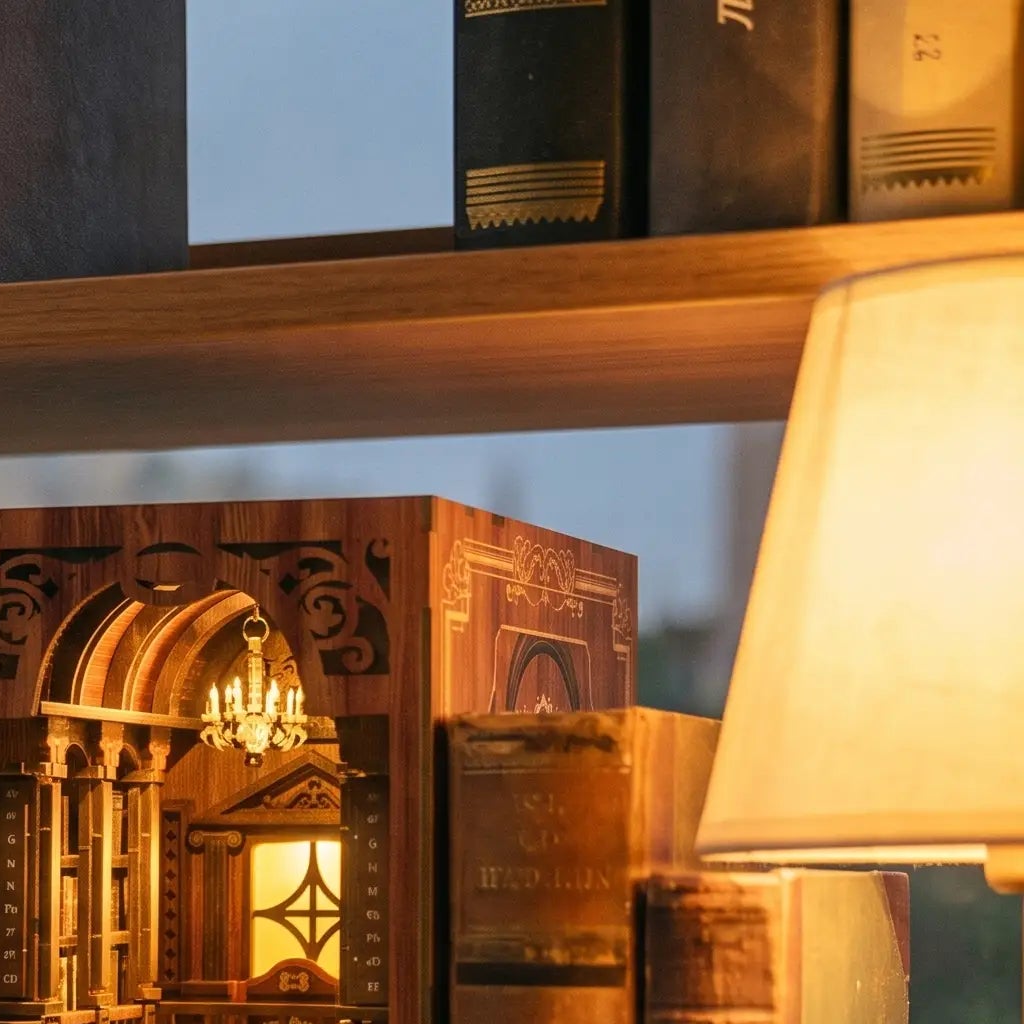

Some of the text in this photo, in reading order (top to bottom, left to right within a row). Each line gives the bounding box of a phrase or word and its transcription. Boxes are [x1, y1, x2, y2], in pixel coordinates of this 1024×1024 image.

[7, 834, 16, 845] G
[7, 859, 16, 868] N
[6, 881, 15, 891] N
[3, 974, 18, 984] CD
